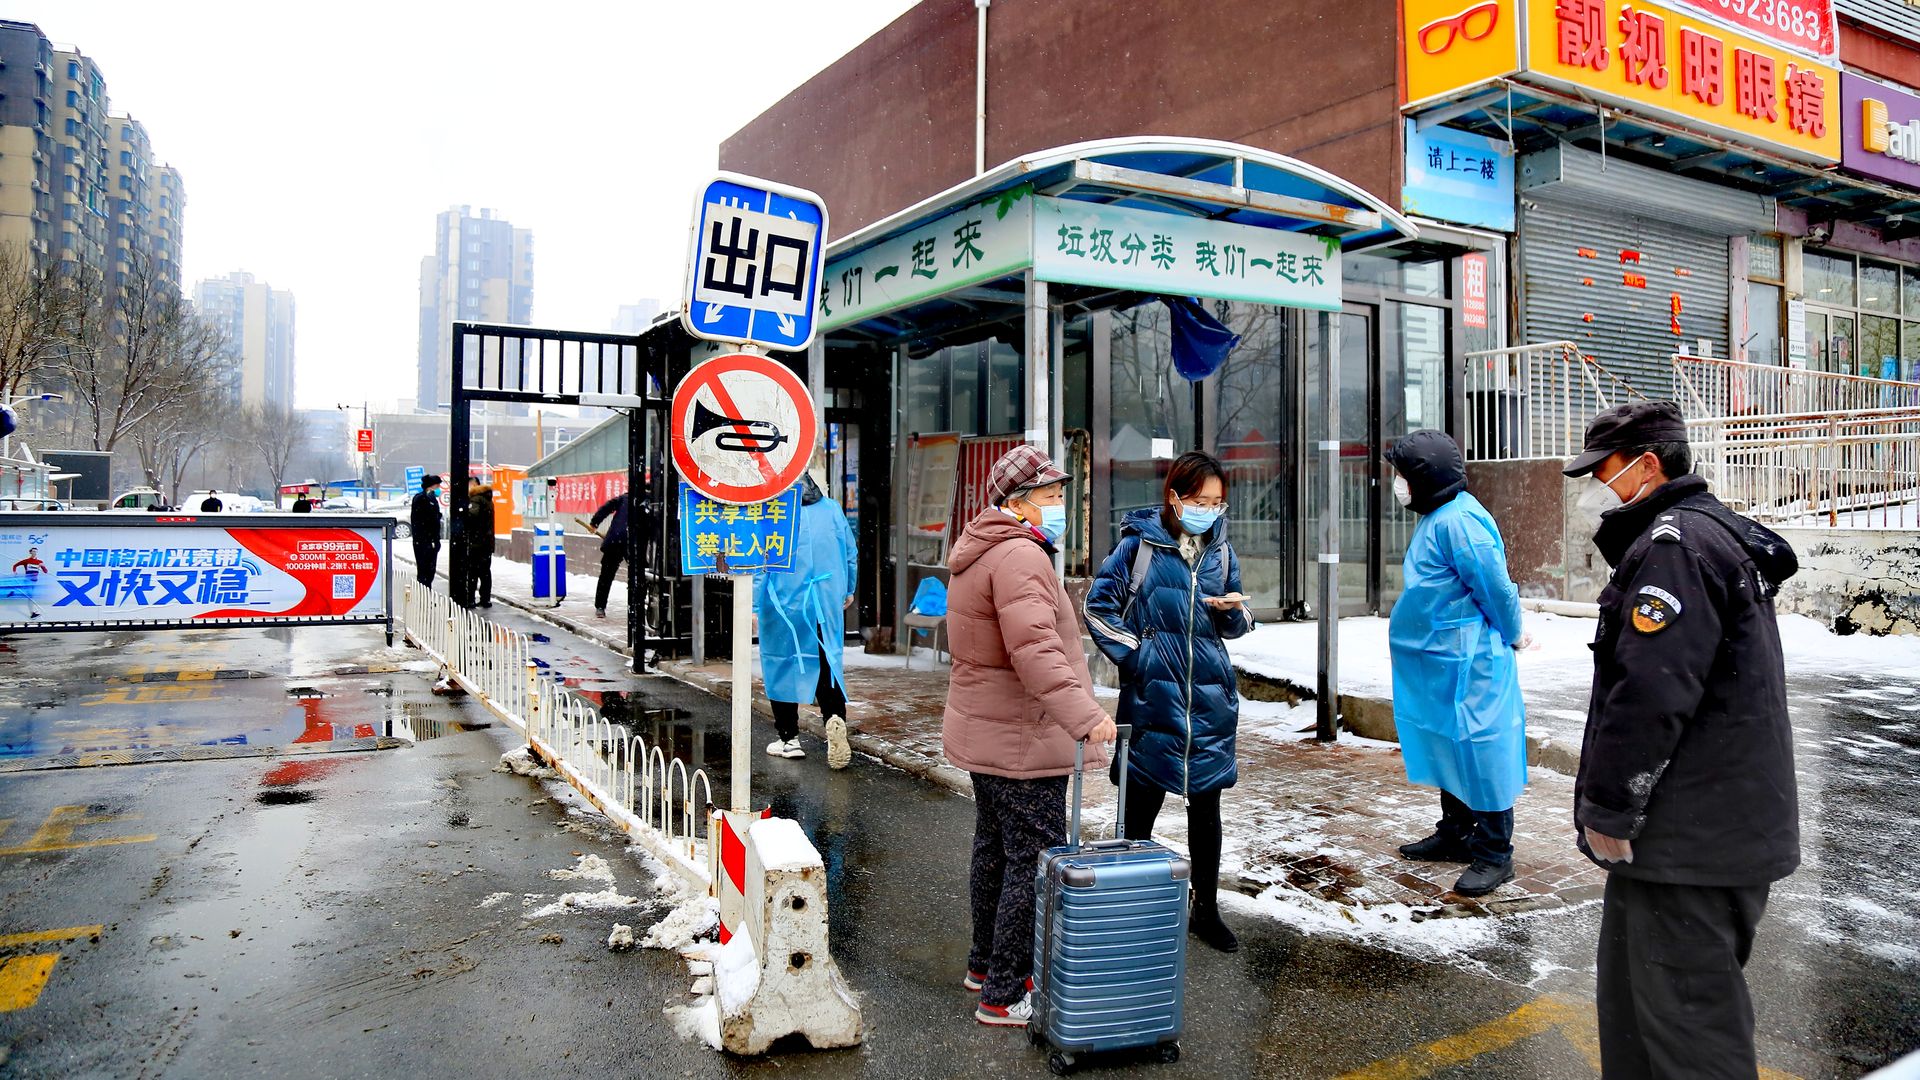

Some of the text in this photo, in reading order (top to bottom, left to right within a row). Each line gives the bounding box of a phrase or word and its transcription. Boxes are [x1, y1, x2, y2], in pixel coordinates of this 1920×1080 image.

[1555, 0, 1826, 139] 靓视明眼镜
[1427, 146, 1496, 181] 请上二楼
[703, 216, 810, 302] 出口
[1057, 223, 1325, 287] 垃圾分类 我们一起来
[1463, 259, 1485, 298] 租
[695, 499, 787, 525] 共享单车
[55, 548, 241, 568] 中国移动光宽带
[695, 531, 785, 557] 禁止入内
[52, 567, 249, 607] 又快又稳
